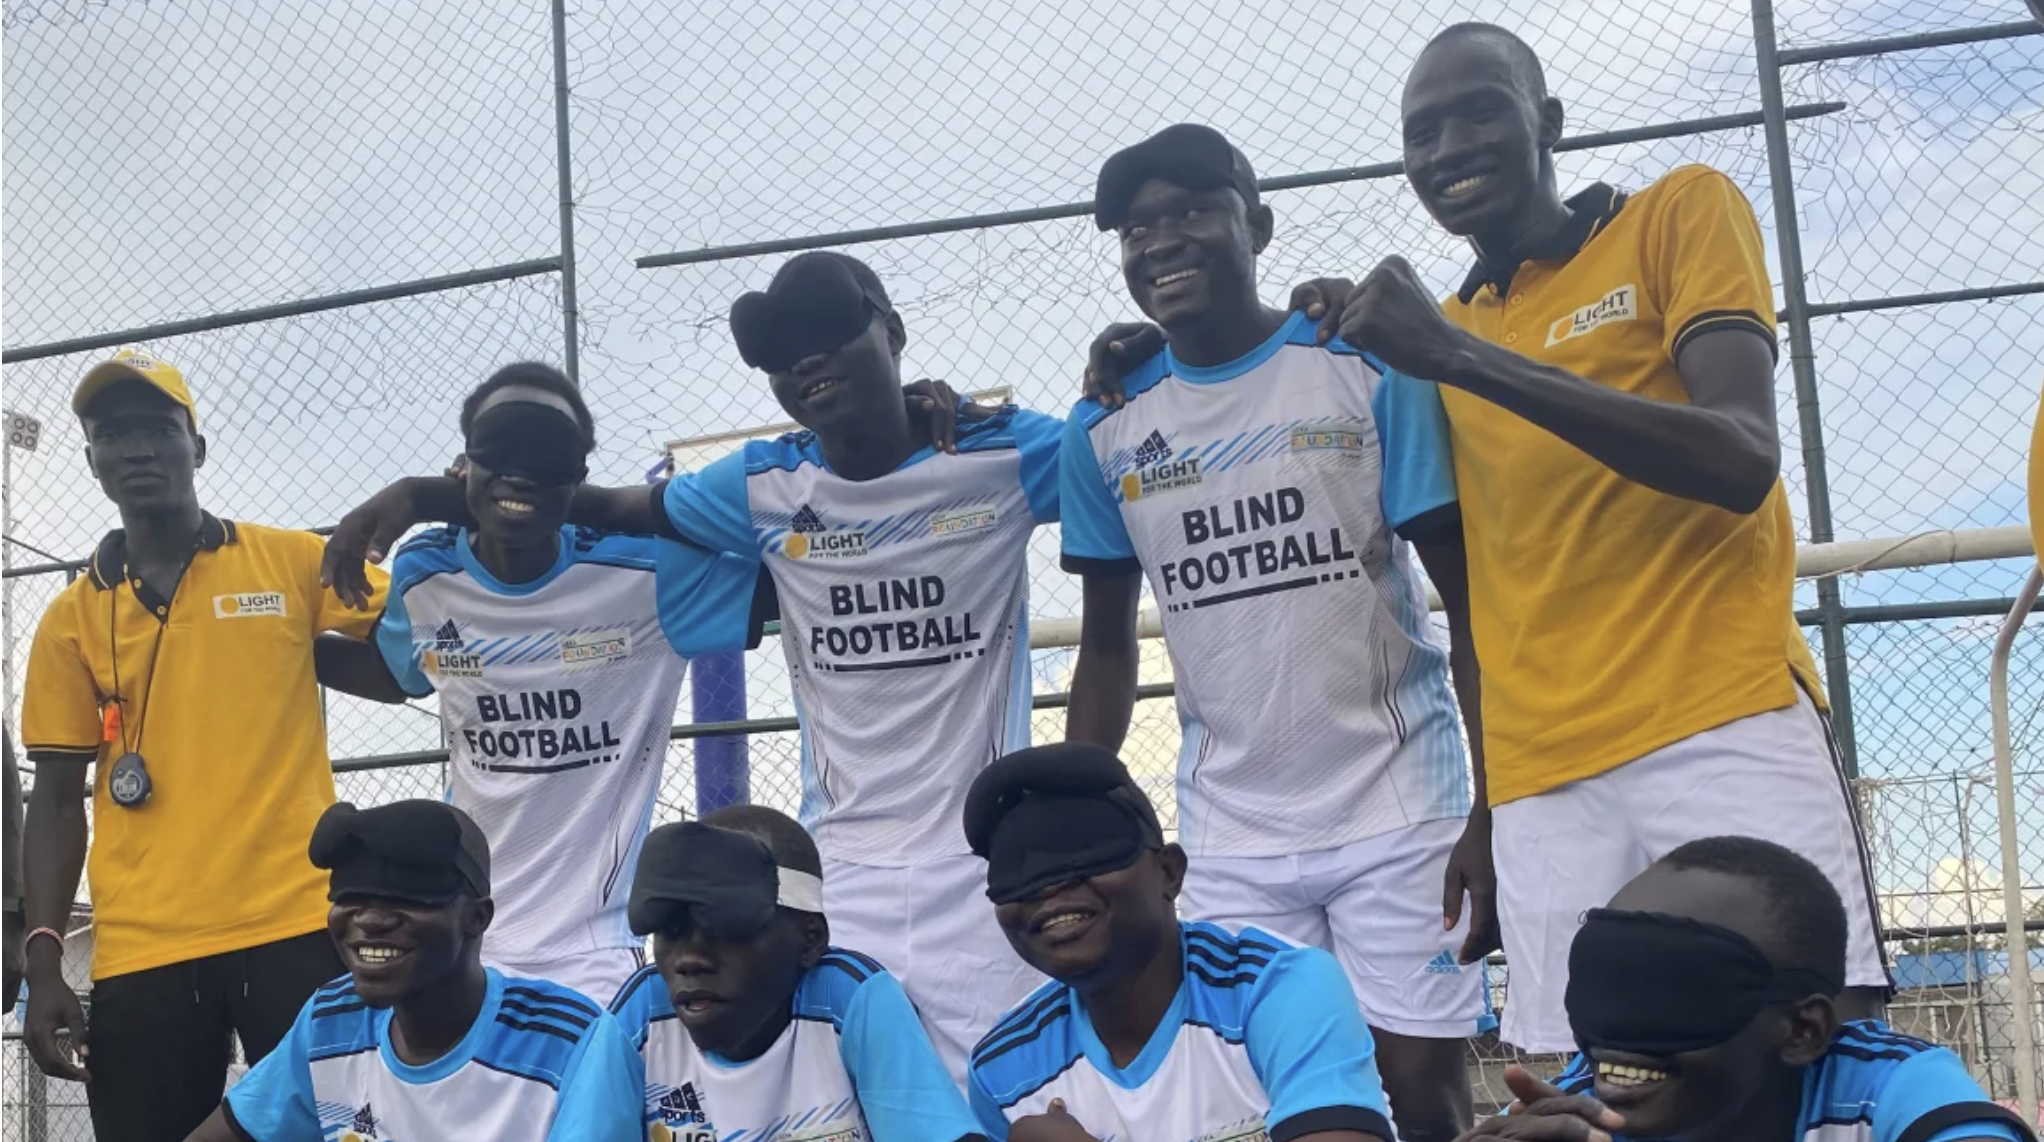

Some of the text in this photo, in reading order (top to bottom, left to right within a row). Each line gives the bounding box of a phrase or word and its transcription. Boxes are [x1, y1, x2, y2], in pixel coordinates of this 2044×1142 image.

[1574, 290, 1628, 325] LIGHT
[1141, 458, 1200, 484] LIGHT
[1157, 482, 1173, 491] THE
[1182, 487, 1305, 545] BLIND
[810, 533, 864, 551] LIGHT
[1160, 527, 1354, 596] FOOTBALL
[239, 595, 280, 606] LIGHT
[829, 575, 945, 616] BLIND
[811, 612, 981, 657] FOOTBALL
[437, 655, 480, 668] LIGHT
[476, 689, 582, 723] BLIND
[463, 721, 620, 759] FOOTBALL
